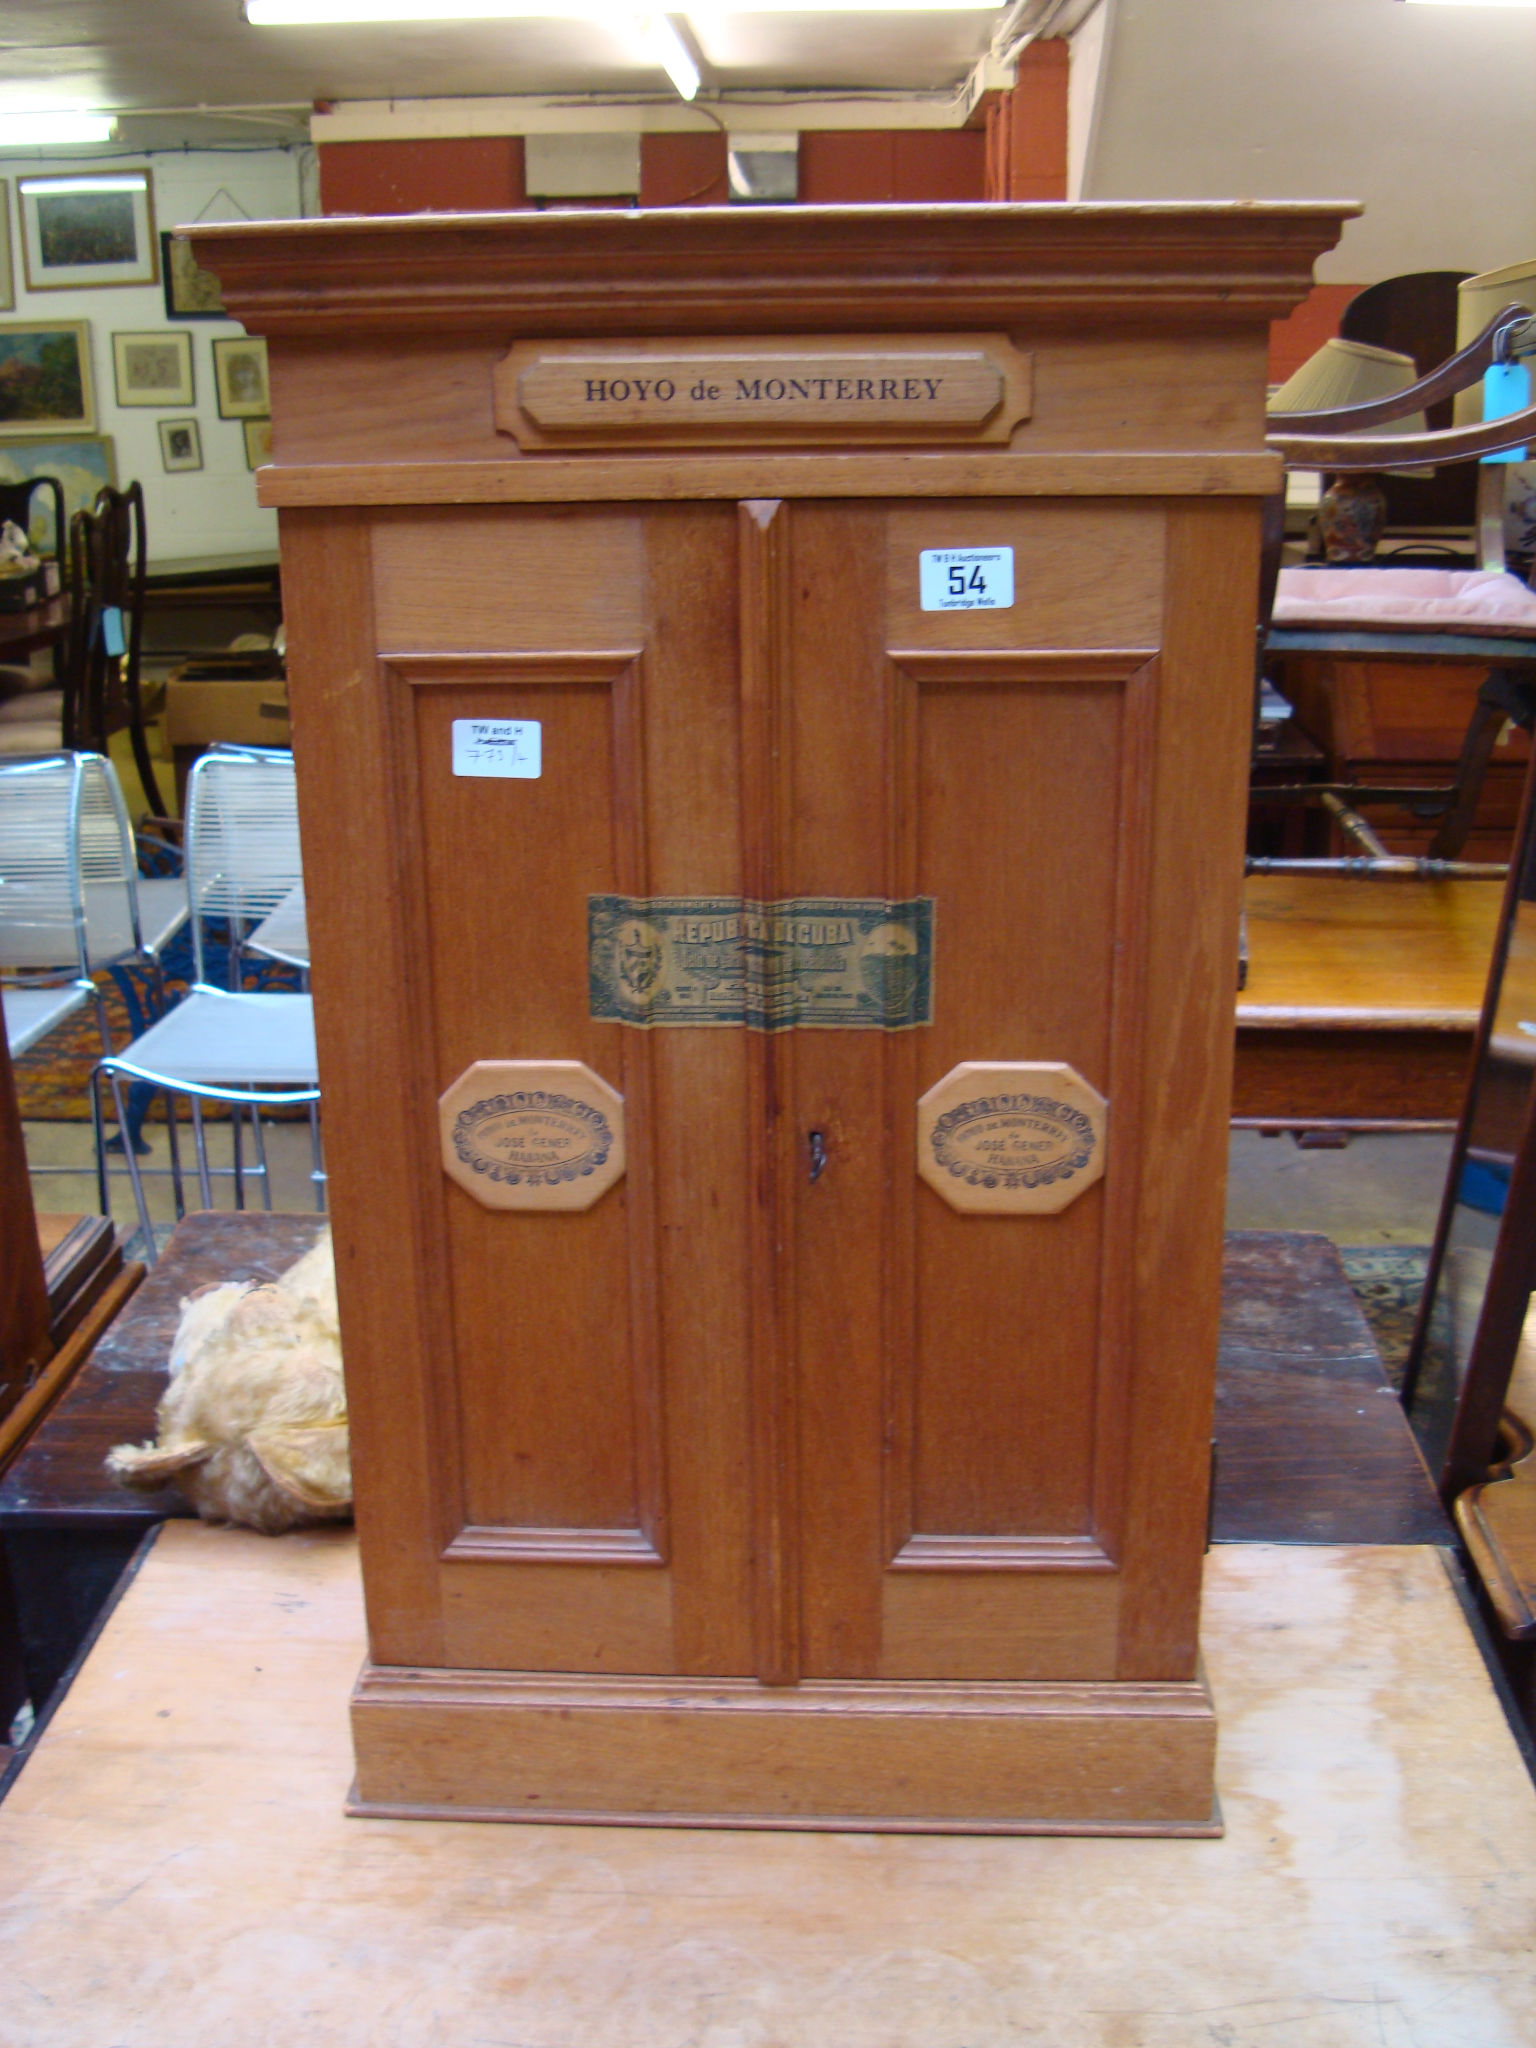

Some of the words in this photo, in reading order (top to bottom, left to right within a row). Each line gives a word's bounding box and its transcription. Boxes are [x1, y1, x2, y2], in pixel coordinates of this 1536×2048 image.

[584, 379, 676, 401] HOYO
[690, 380, 720, 401] de
[735, 378, 944, 401] MONTERREY
[948, 565, 987, 595] 54
[471, 725, 489, 734] TW
[491, 726, 512, 736] and
